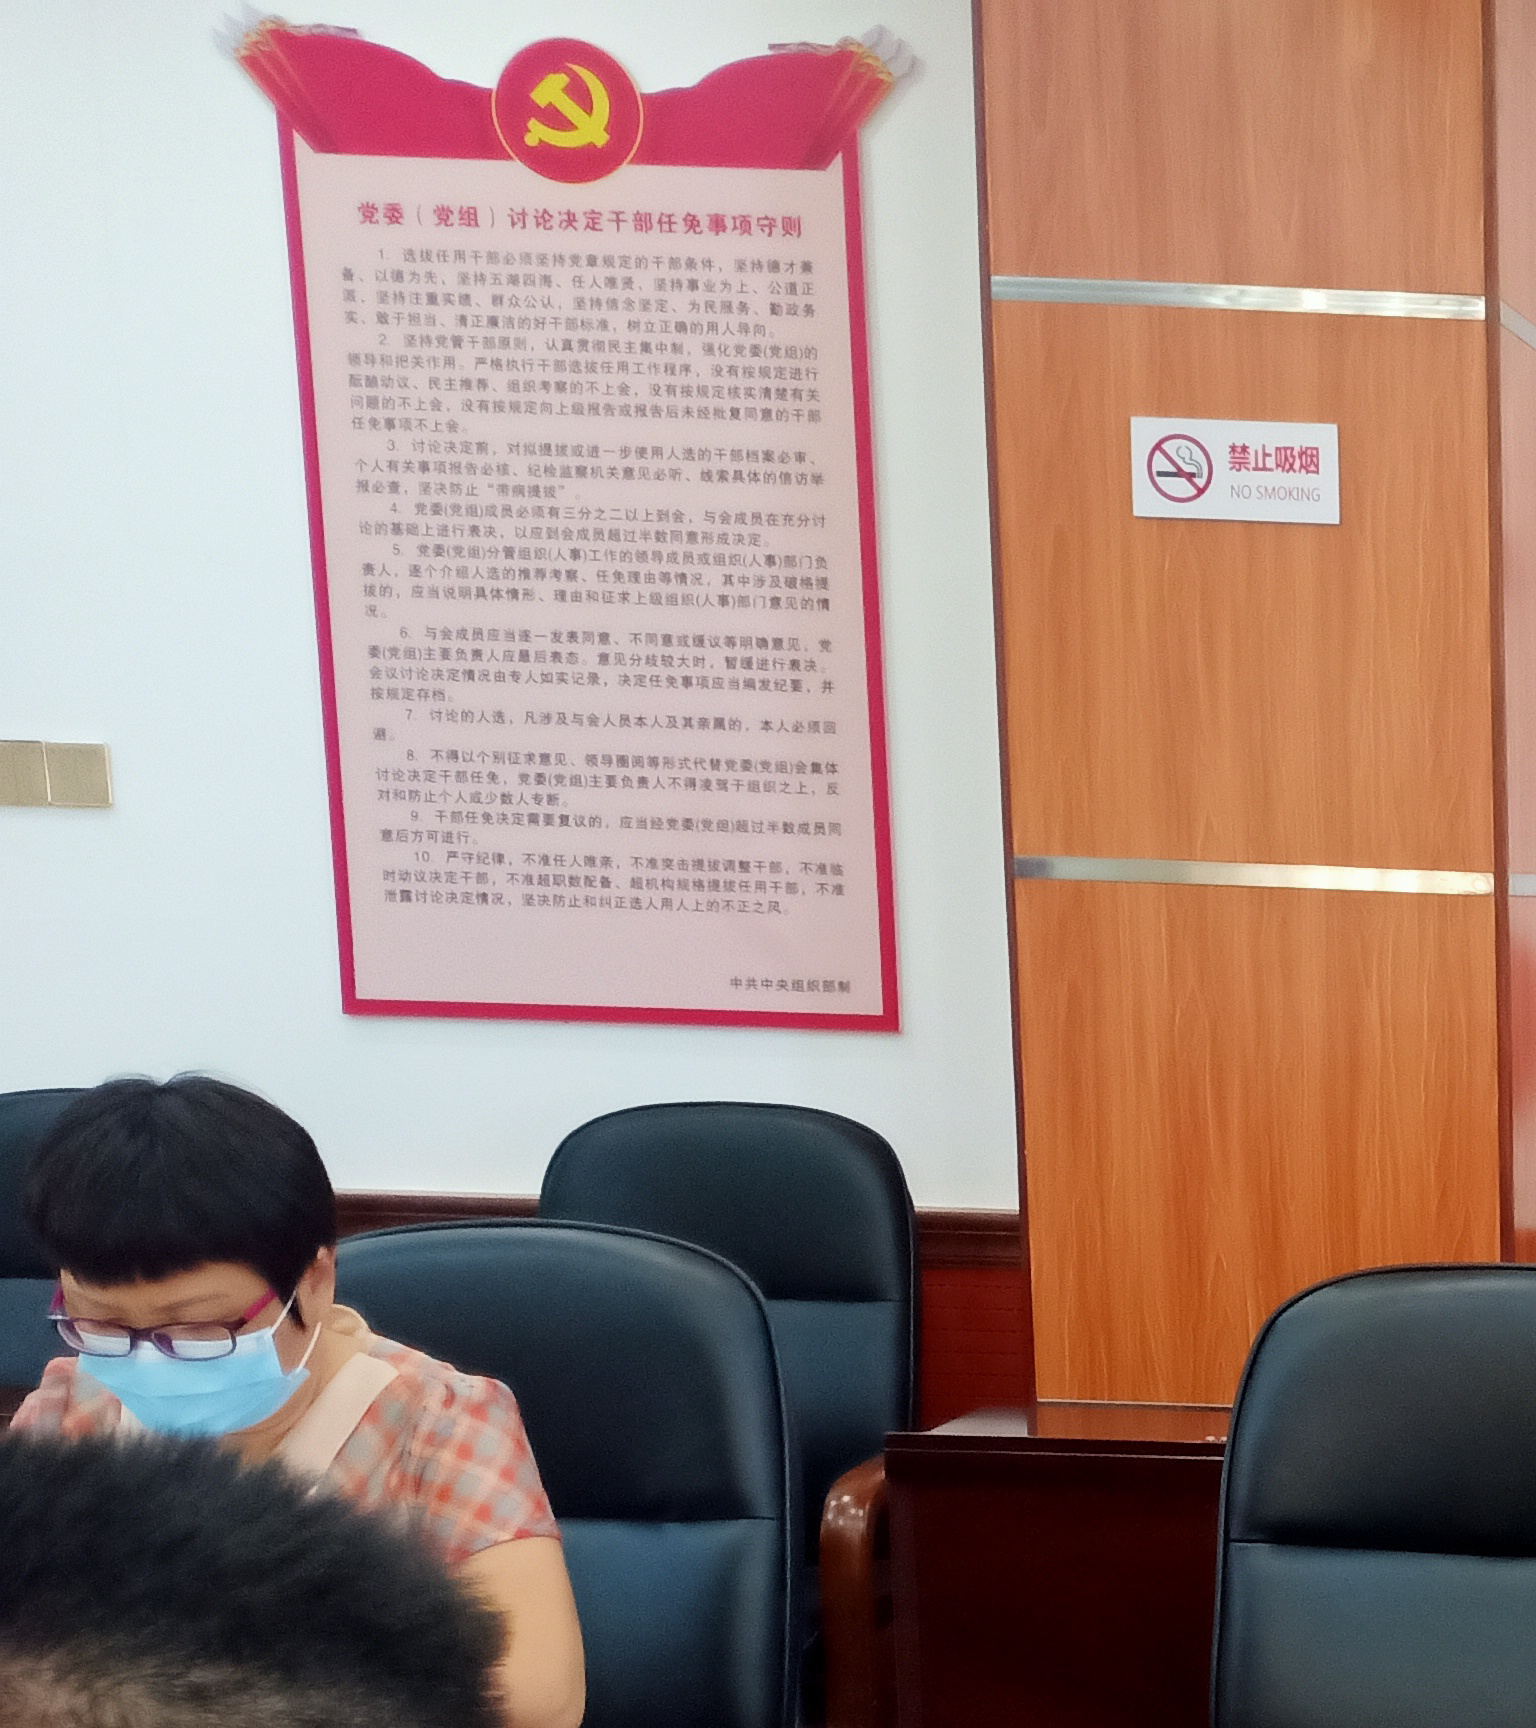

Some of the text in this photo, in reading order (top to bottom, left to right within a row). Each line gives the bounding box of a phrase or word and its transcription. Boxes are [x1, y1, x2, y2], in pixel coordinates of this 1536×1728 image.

[1228, 442, 1320, 476] 禁止吸烟
[1230, 484, 1321, 503] NO SMOKING
